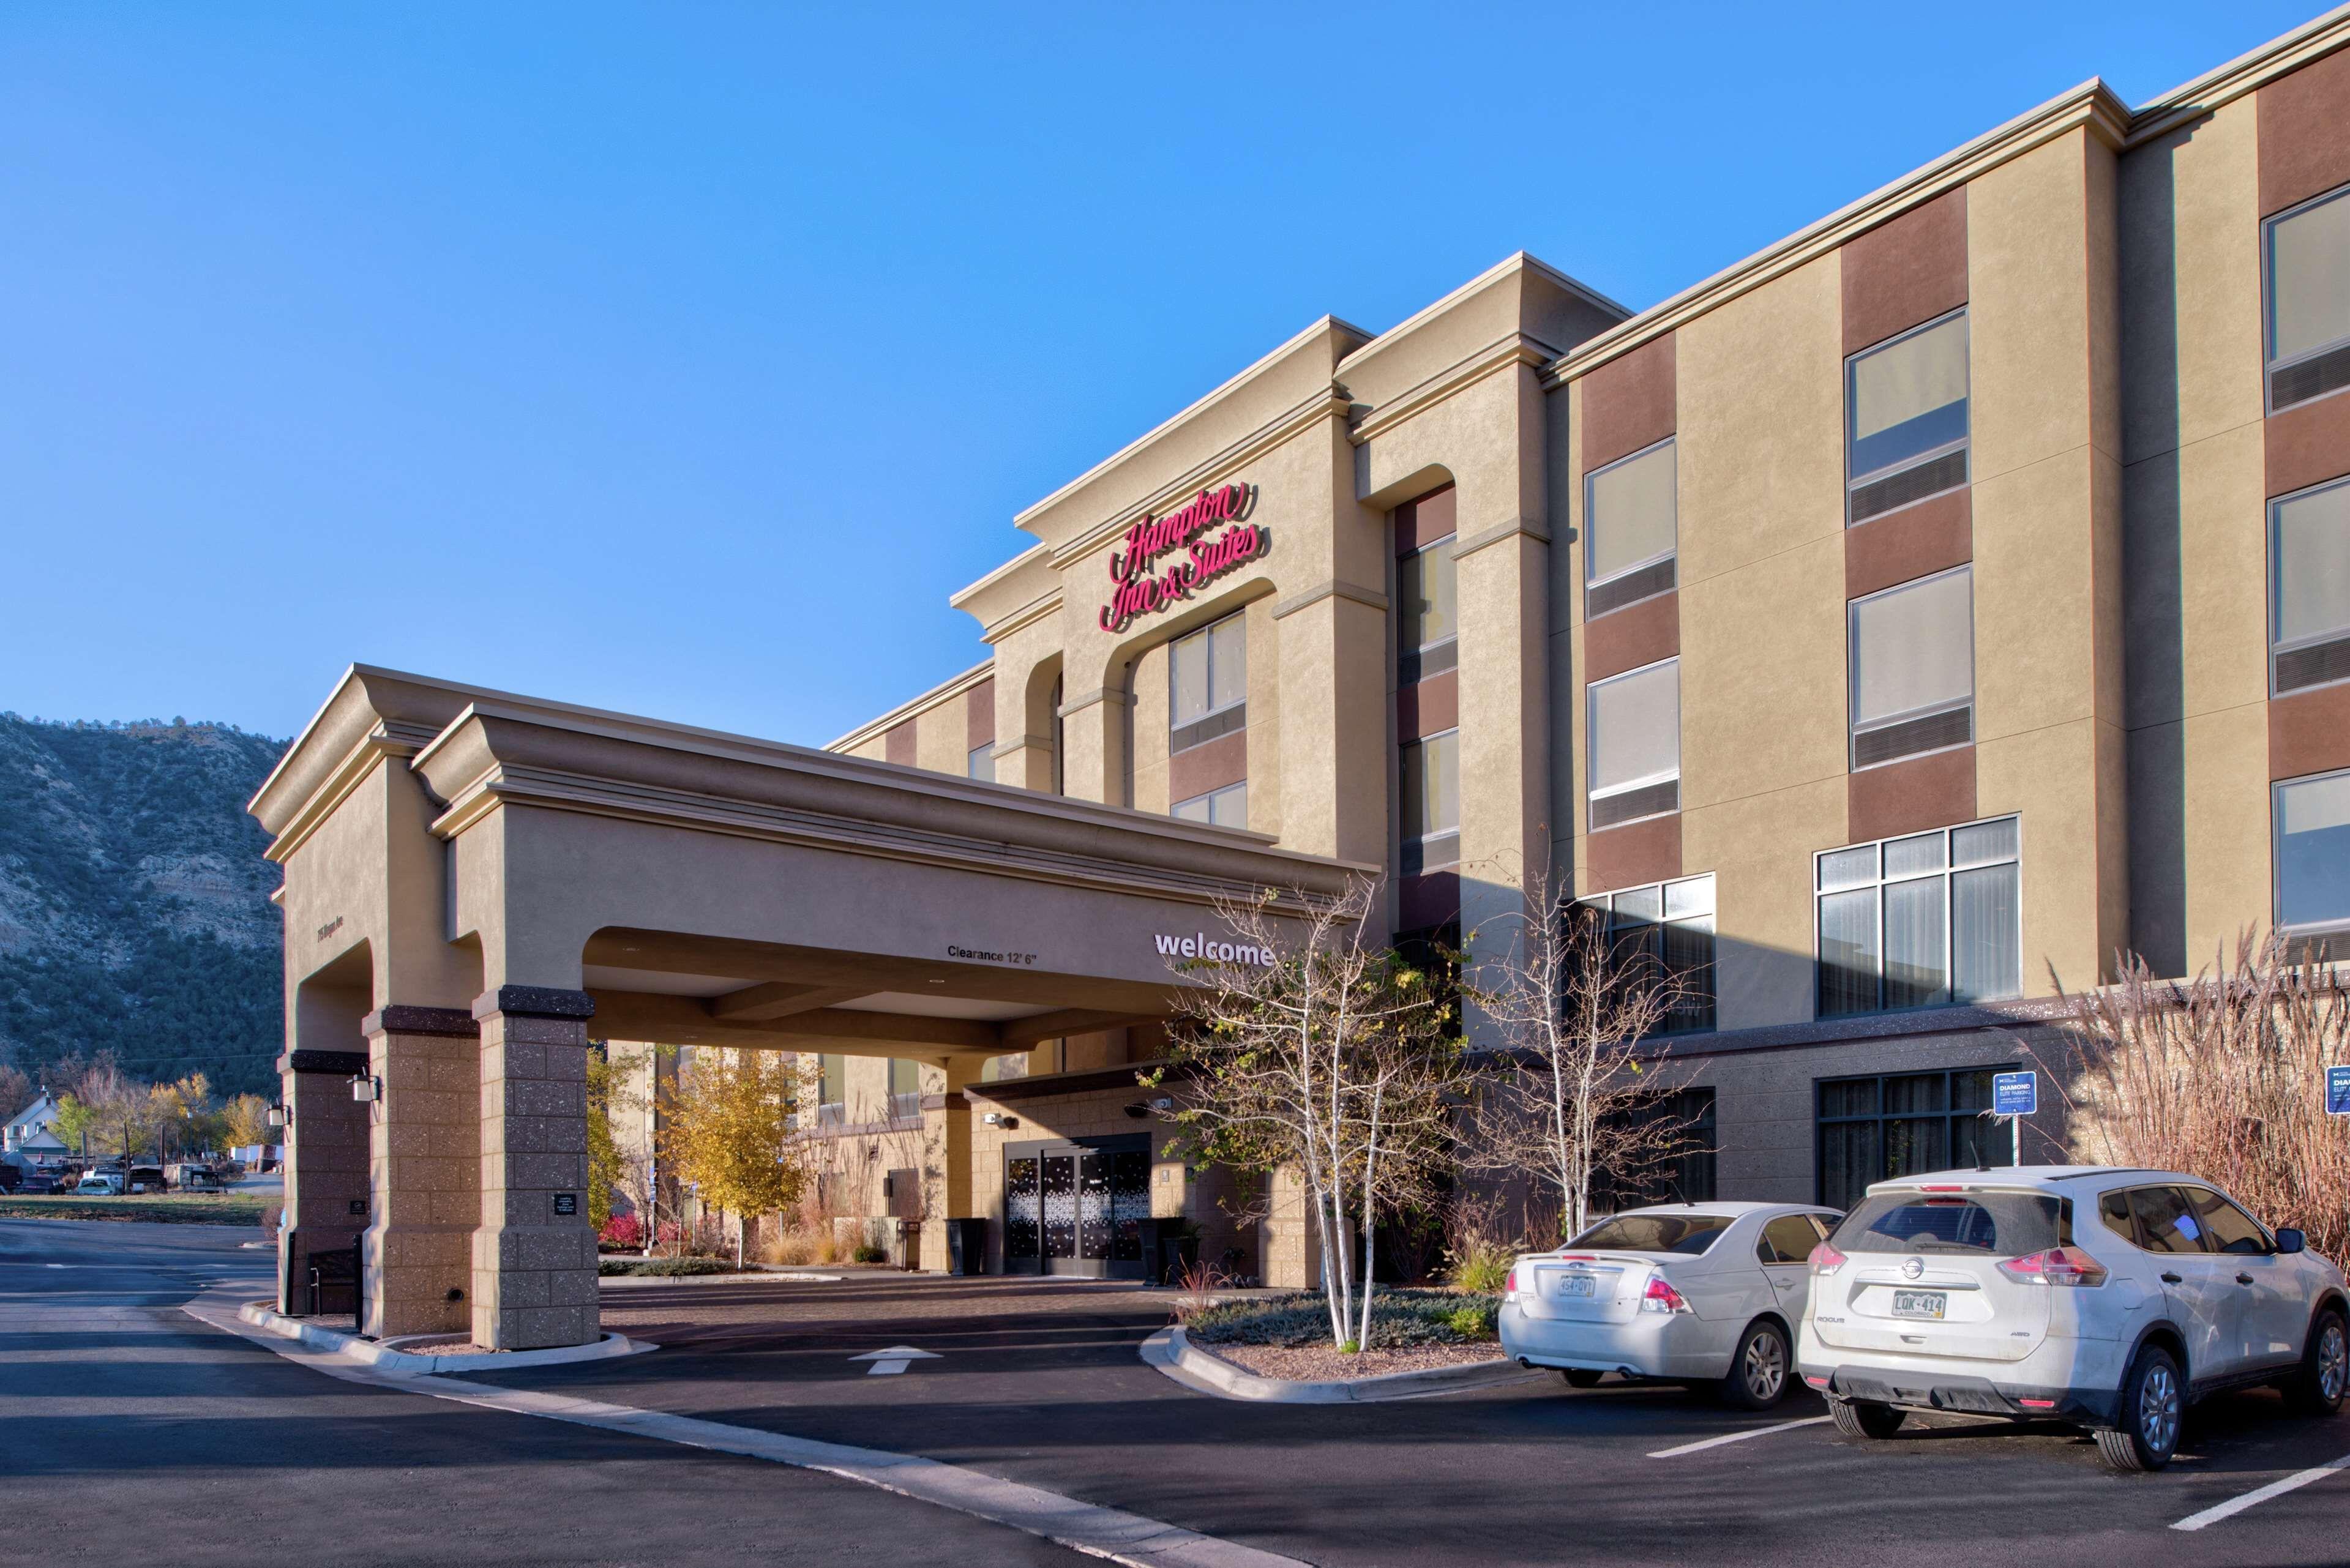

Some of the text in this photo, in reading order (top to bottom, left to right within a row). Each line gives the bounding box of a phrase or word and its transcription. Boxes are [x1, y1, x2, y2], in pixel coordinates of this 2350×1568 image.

[1110, 482, 1249, 584] Hampton
[1099, 524, 1259, 632] Inn & Suites
[948, 945, 1004, 961] Clearance
[1154, 932, 1274, 967] welcome
